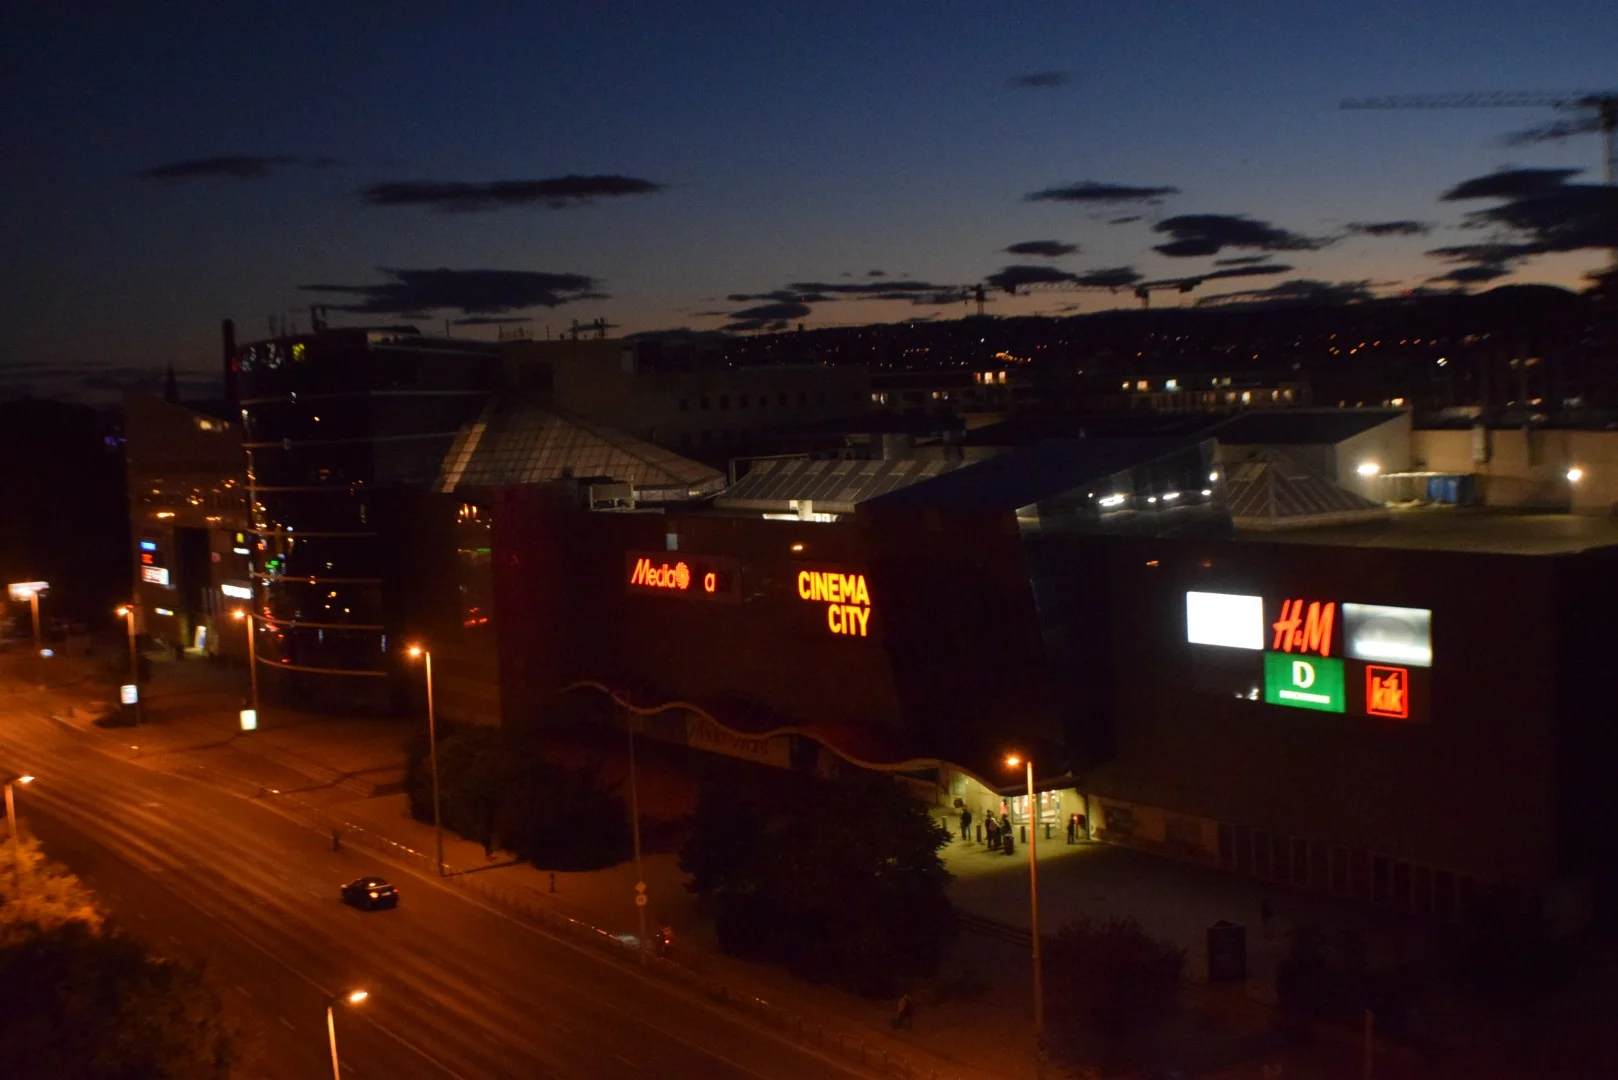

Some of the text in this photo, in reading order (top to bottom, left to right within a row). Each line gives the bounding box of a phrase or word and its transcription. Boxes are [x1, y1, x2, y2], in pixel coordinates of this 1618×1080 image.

[630, 558, 676, 589] Media
[797, 570, 871, 606] CINEMA
[827, 604, 871, 637] CITY
[1272, 598, 1335, 657] H&M
